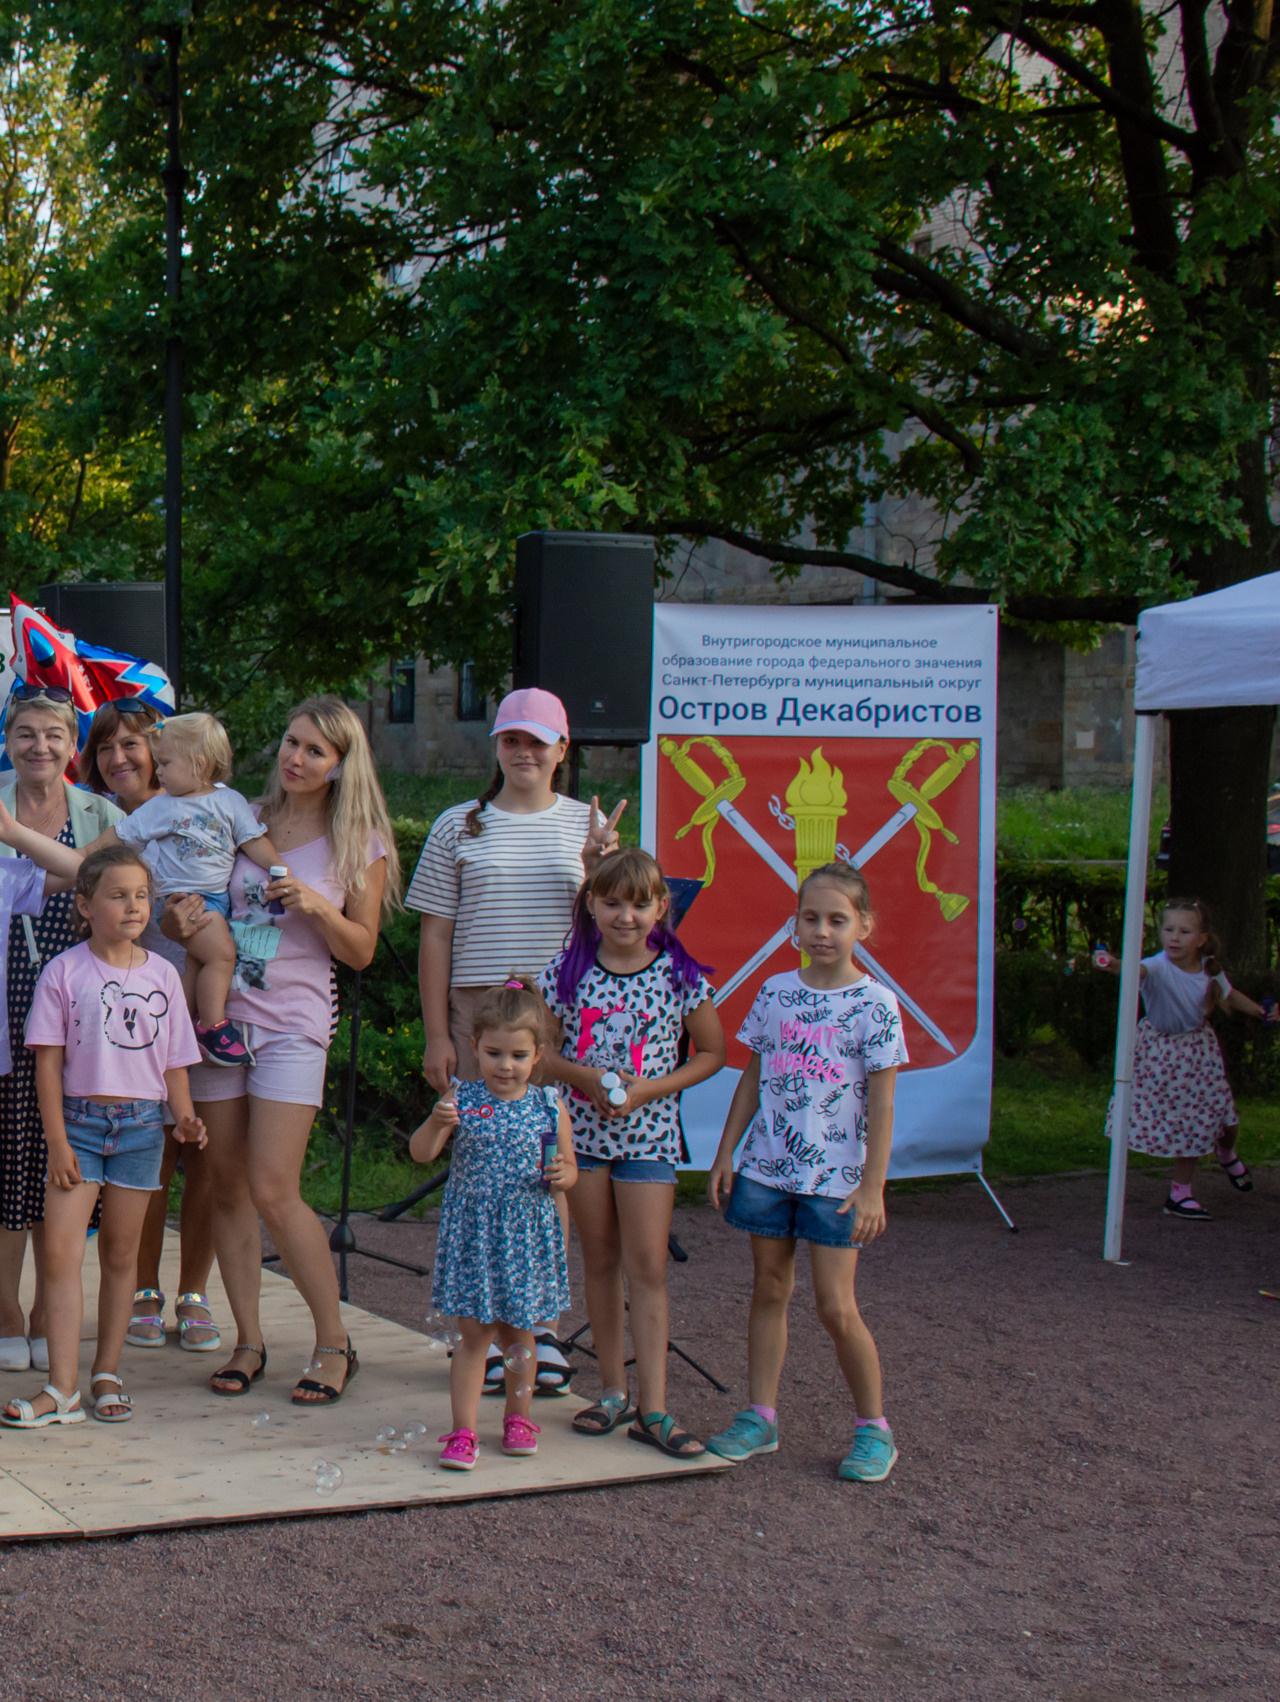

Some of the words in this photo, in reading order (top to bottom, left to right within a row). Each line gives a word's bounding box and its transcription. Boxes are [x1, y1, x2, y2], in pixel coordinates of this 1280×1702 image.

[701, 635, 822, 650] Внутригородское
[825, 637, 938, 650] муниципальное
[662, 653, 753, 669] образование
[757, 657, 805, 670] города
[809, 655, 911, 670] федерального
[914, 659, 983, 669] значения
[662, 673, 801, 690] Санкт-Петербурга
[805, 676, 934, 691] муниципальный
[938, 678, 983, 692] округ
[658, 696, 768, 727] Остров
[776, 697, 983, 728] Декабристов
[780, 1019, 842, 1049] WHAT
[766, 1051, 846, 1084] HAPPENS
